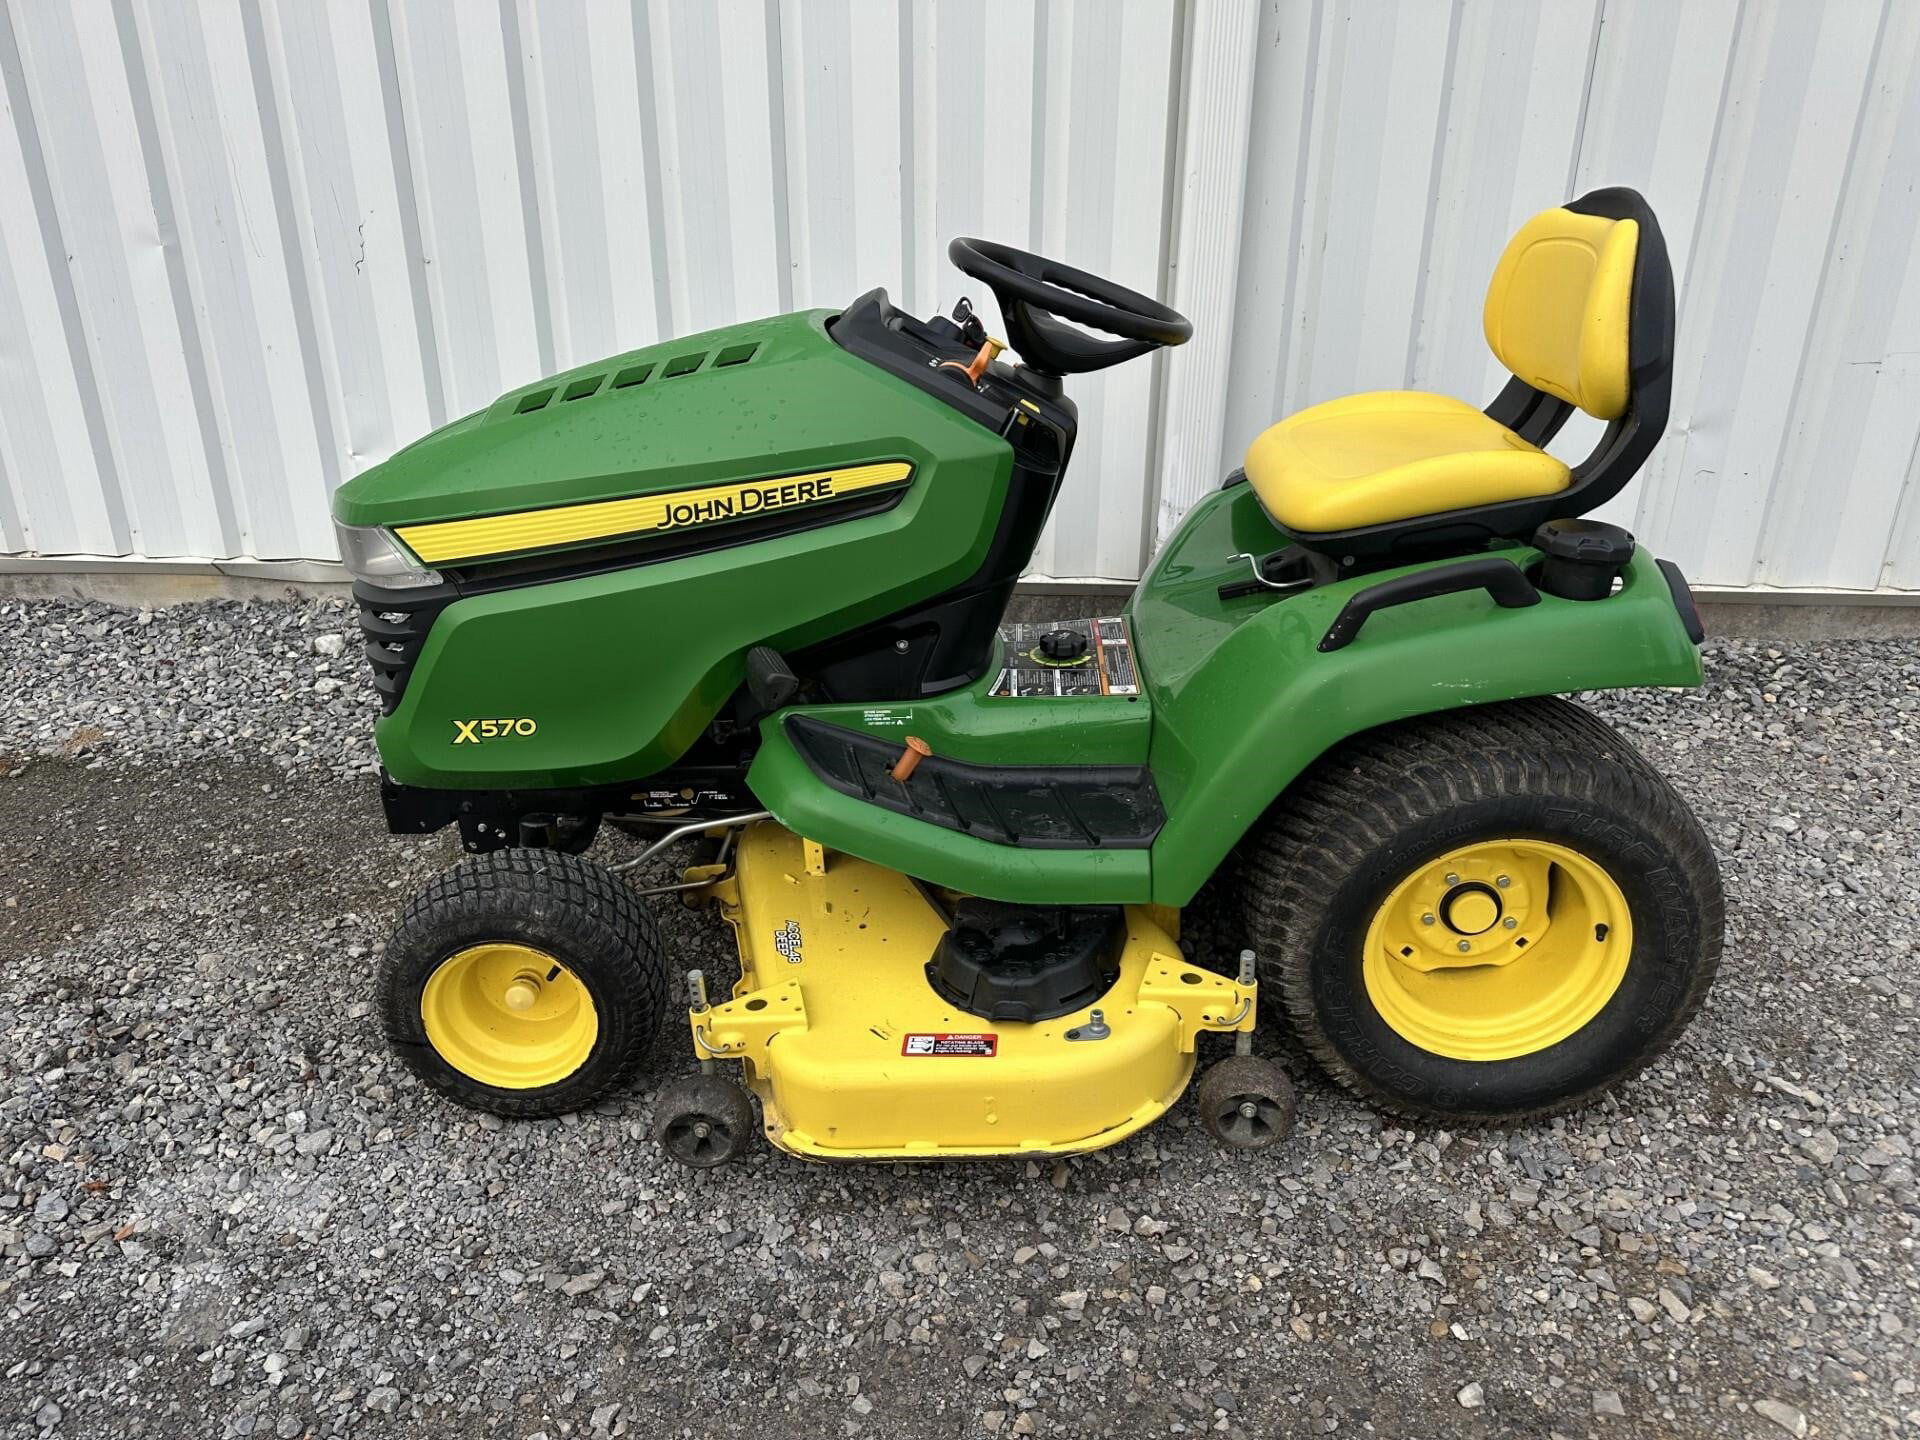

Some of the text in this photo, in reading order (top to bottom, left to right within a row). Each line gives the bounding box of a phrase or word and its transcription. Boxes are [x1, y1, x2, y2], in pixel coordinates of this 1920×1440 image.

[657, 478, 833, 527] JOHN DEERE
[452, 718, 537, 744] X570
[1545, 807, 1690, 1033] TURF MASTER
[775, 930, 789, 956] DEEP
